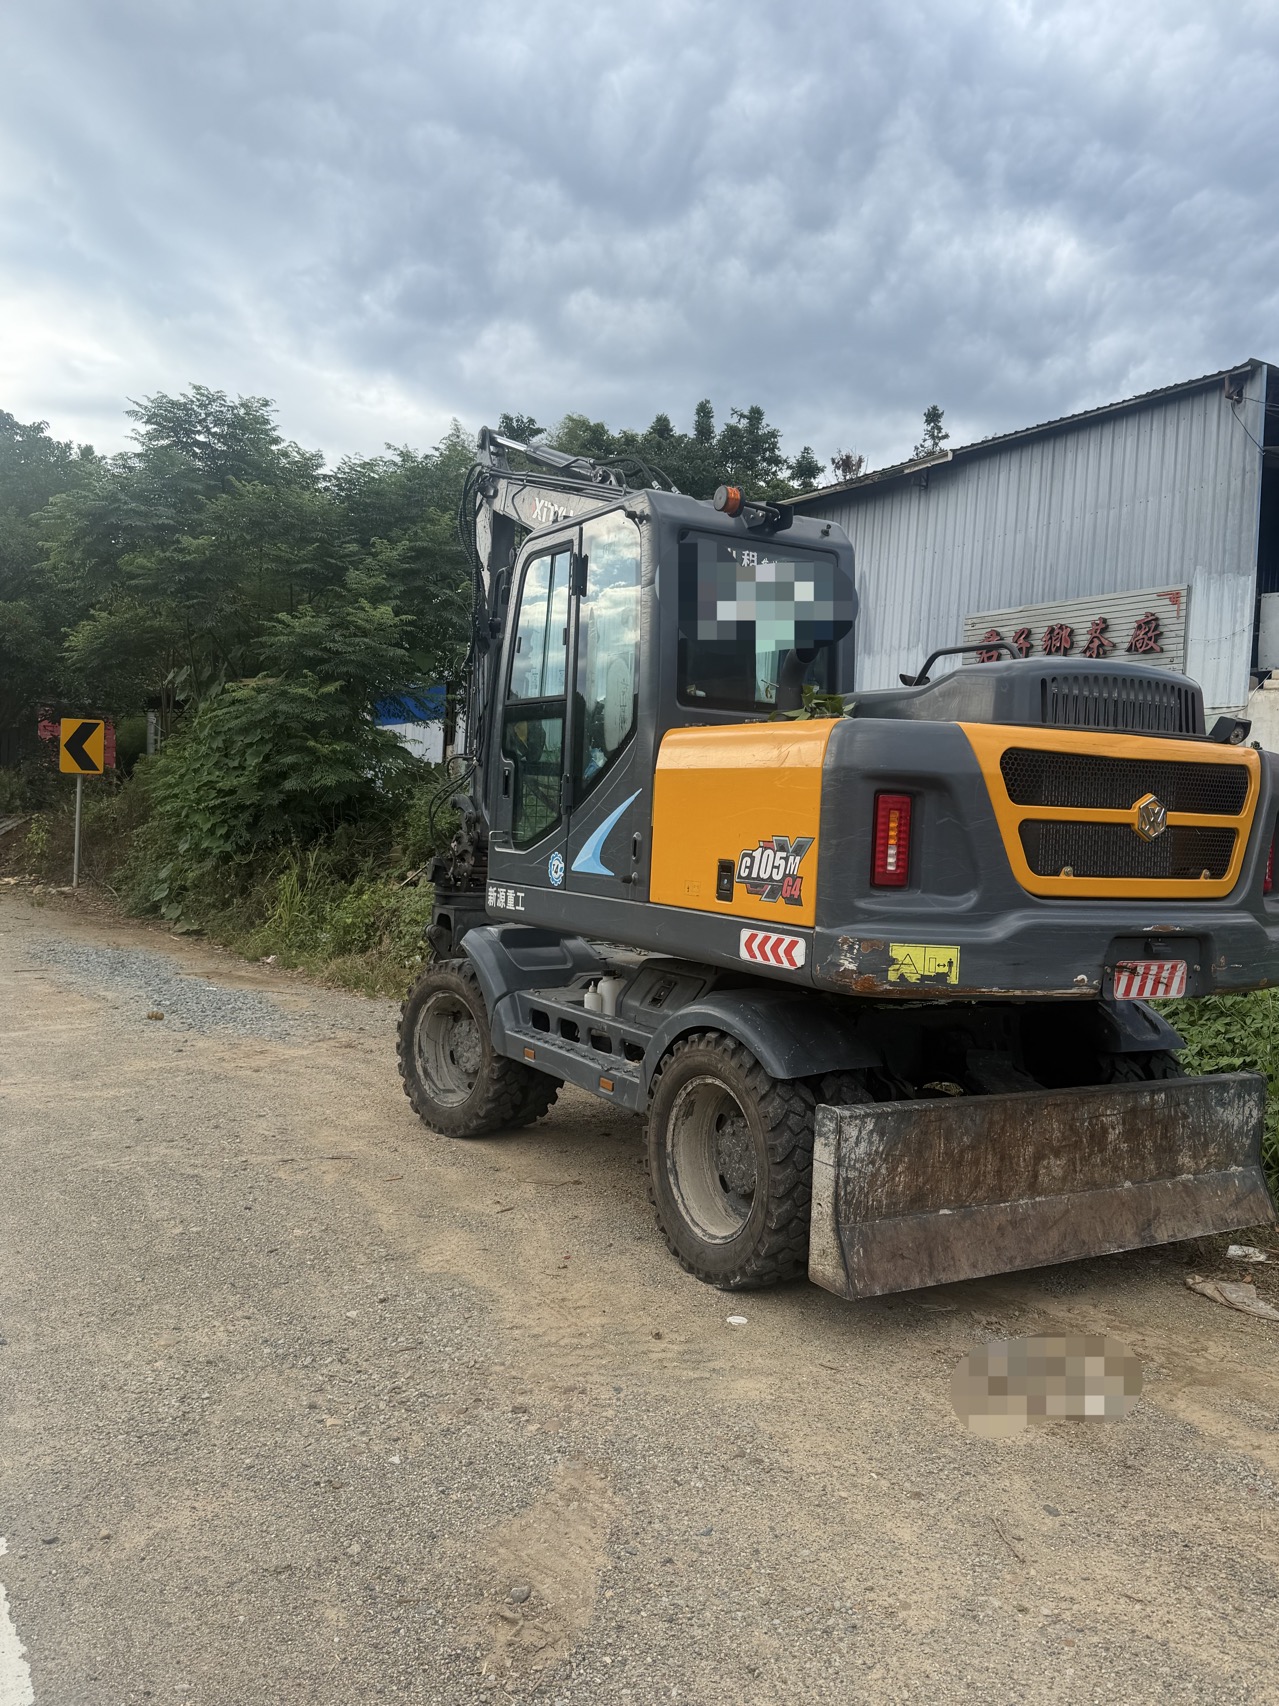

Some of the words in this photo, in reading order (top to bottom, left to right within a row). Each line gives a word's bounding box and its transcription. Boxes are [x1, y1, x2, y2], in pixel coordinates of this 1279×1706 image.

[487, 886, 525, 911] 新源重工
[781, 876, 802, 899] G4
